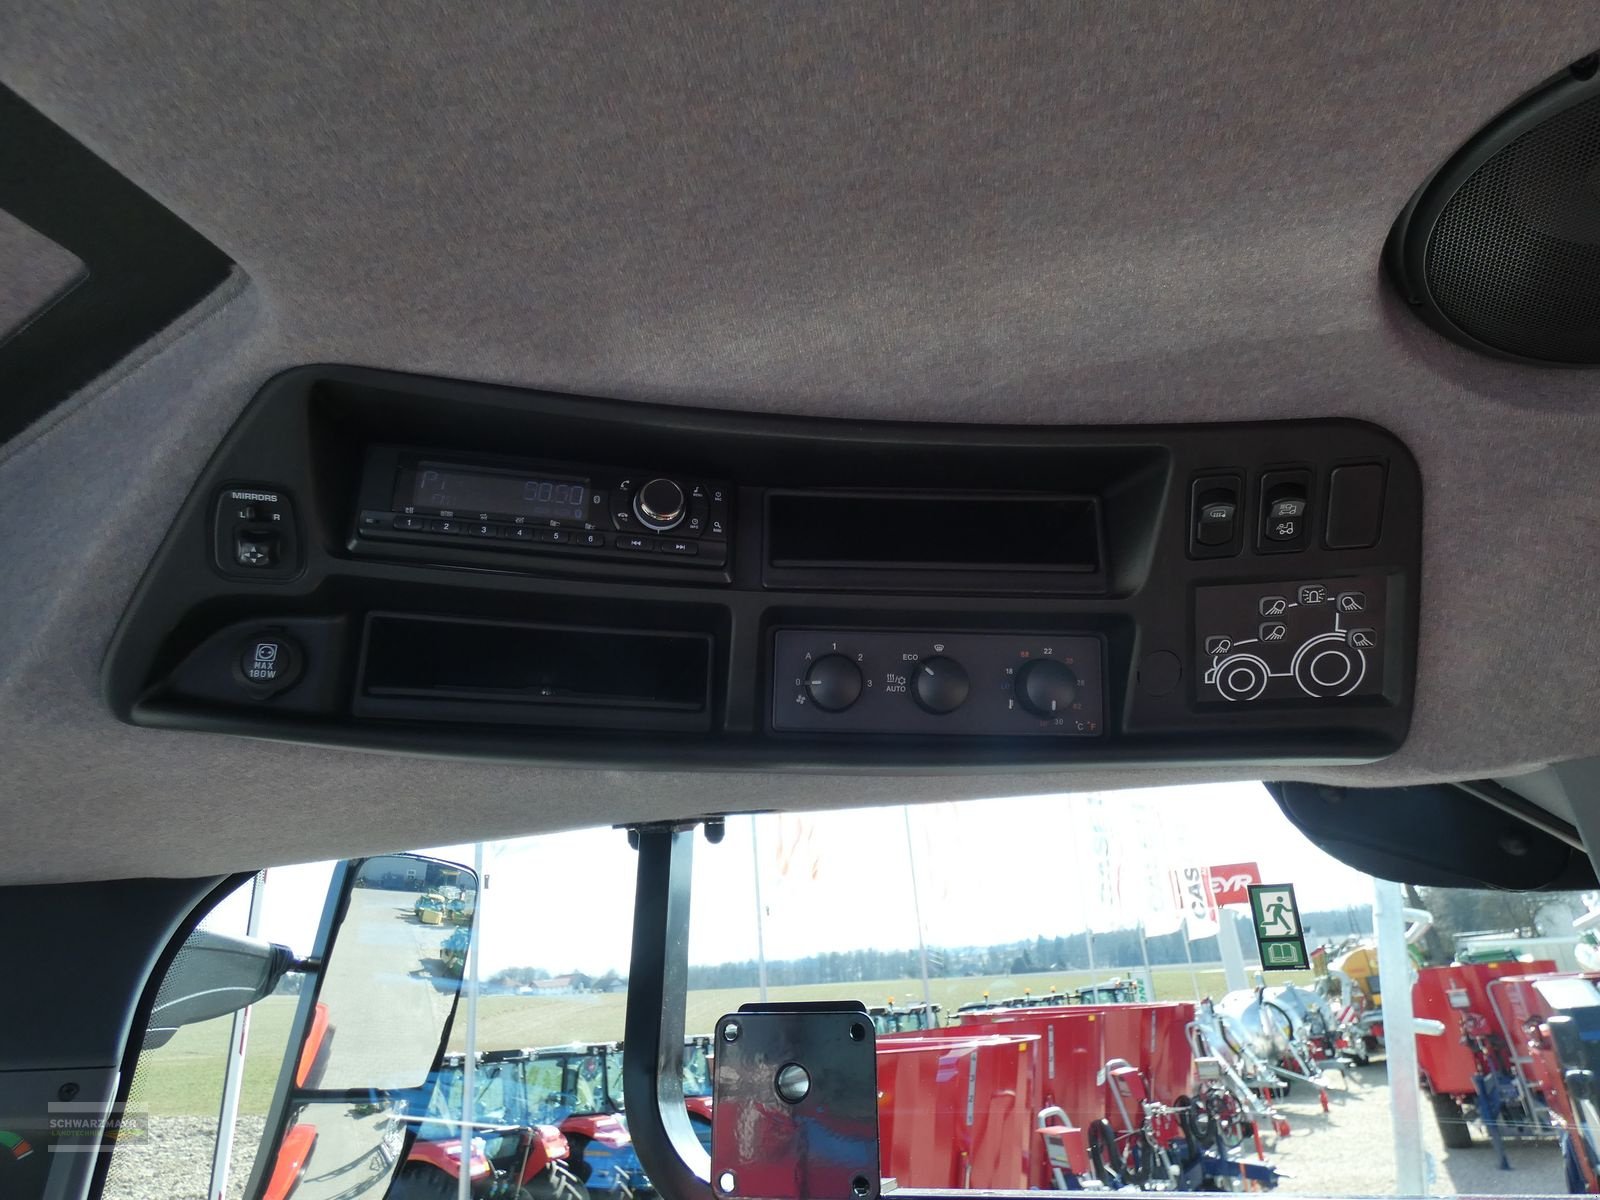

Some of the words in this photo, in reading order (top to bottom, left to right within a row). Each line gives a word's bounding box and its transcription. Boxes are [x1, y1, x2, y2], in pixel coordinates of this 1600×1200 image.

[231, 491, 278, 502] MIRRORS
[272, 513, 281, 521] R
[1043, 647, 1053, 655] 22
[805, 652, 812, 660] A
[857, 653, 864, 661] 2
[902, 653, 919, 662] ECO
[253, 661, 274, 670] MAX
[249, 669, 277, 679] 180W
[867, 679, 873, 687] 3
[886, 685, 907, 693] AUTO
